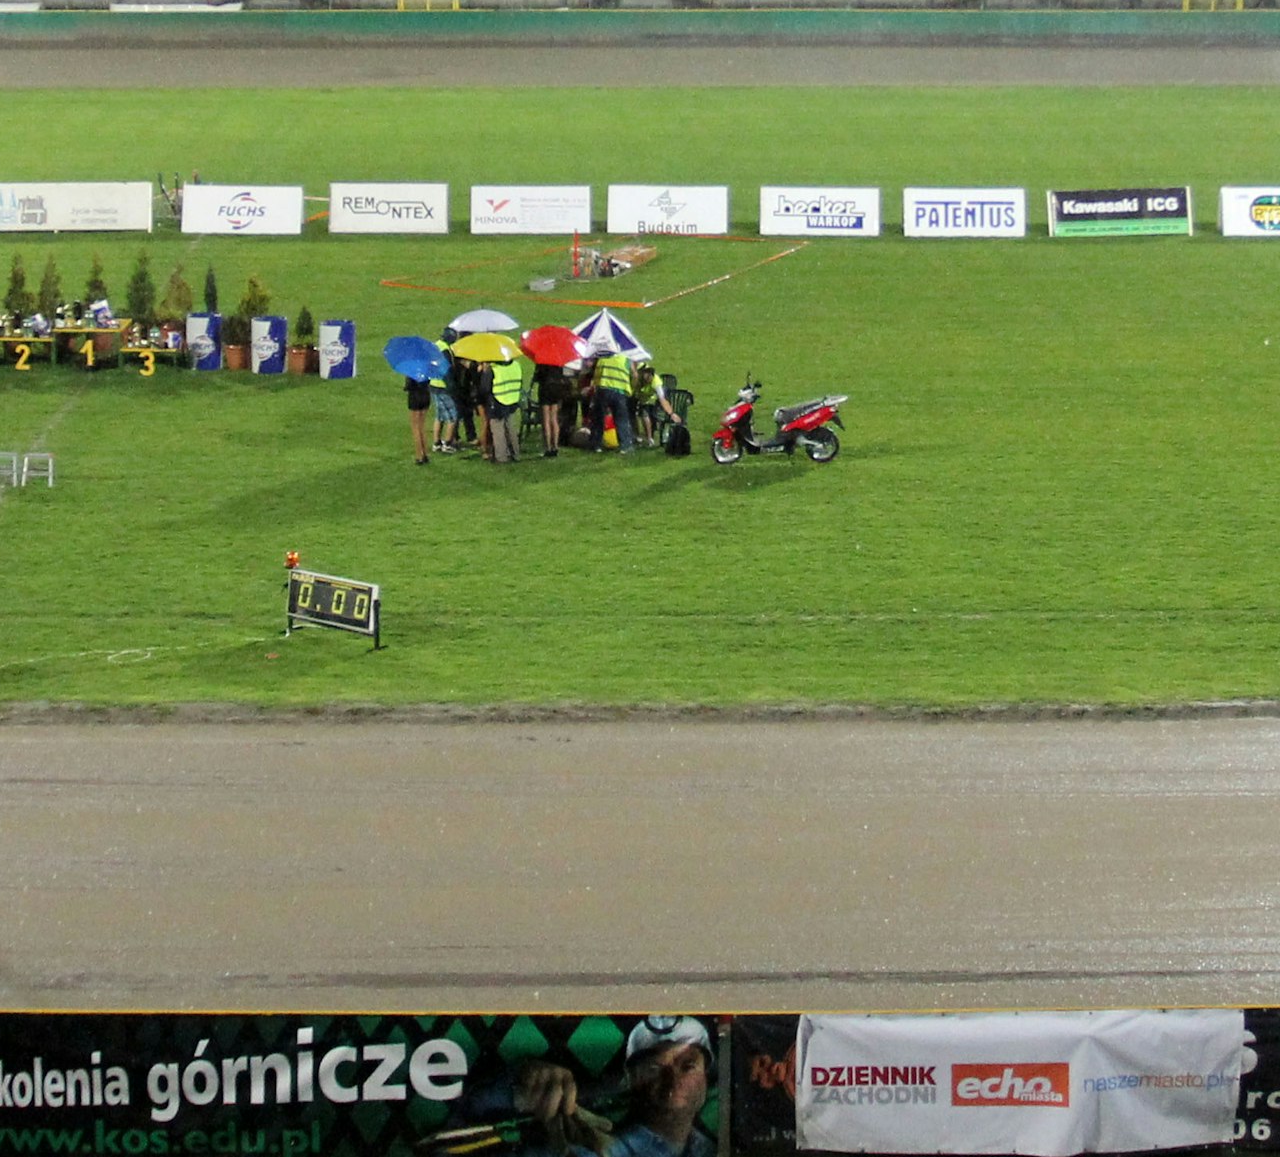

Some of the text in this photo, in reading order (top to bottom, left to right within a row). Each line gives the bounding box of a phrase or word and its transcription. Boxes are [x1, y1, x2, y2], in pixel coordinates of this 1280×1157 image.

[217, 205, 266, 218] FUCHS
[914, 200, 1016, 229] PATENTUS
[1062, 196, 1179, 214] Kawasaki ICG
[474, 215, 518, 225] MINOVA
[637, 220, 698, 235] Budexim
[807, 216, 858, 229] WARKOP
[14, 344, 31, 371] 2
[79, 339, 95, 367] 1
[138, 351, 156, 377] 3
[147, 1026, 469, 1123] górnicze
[811, 1065, 937, 1087] DZIENNIK
[956, 1067, 1052, 1100] echo
[1083, 1070, 1228, 1094] naszemiasto.pl
[812, 1086, 937, 1106] ZACHODNI
[1019, 1091, 1064, 1104] miasta
